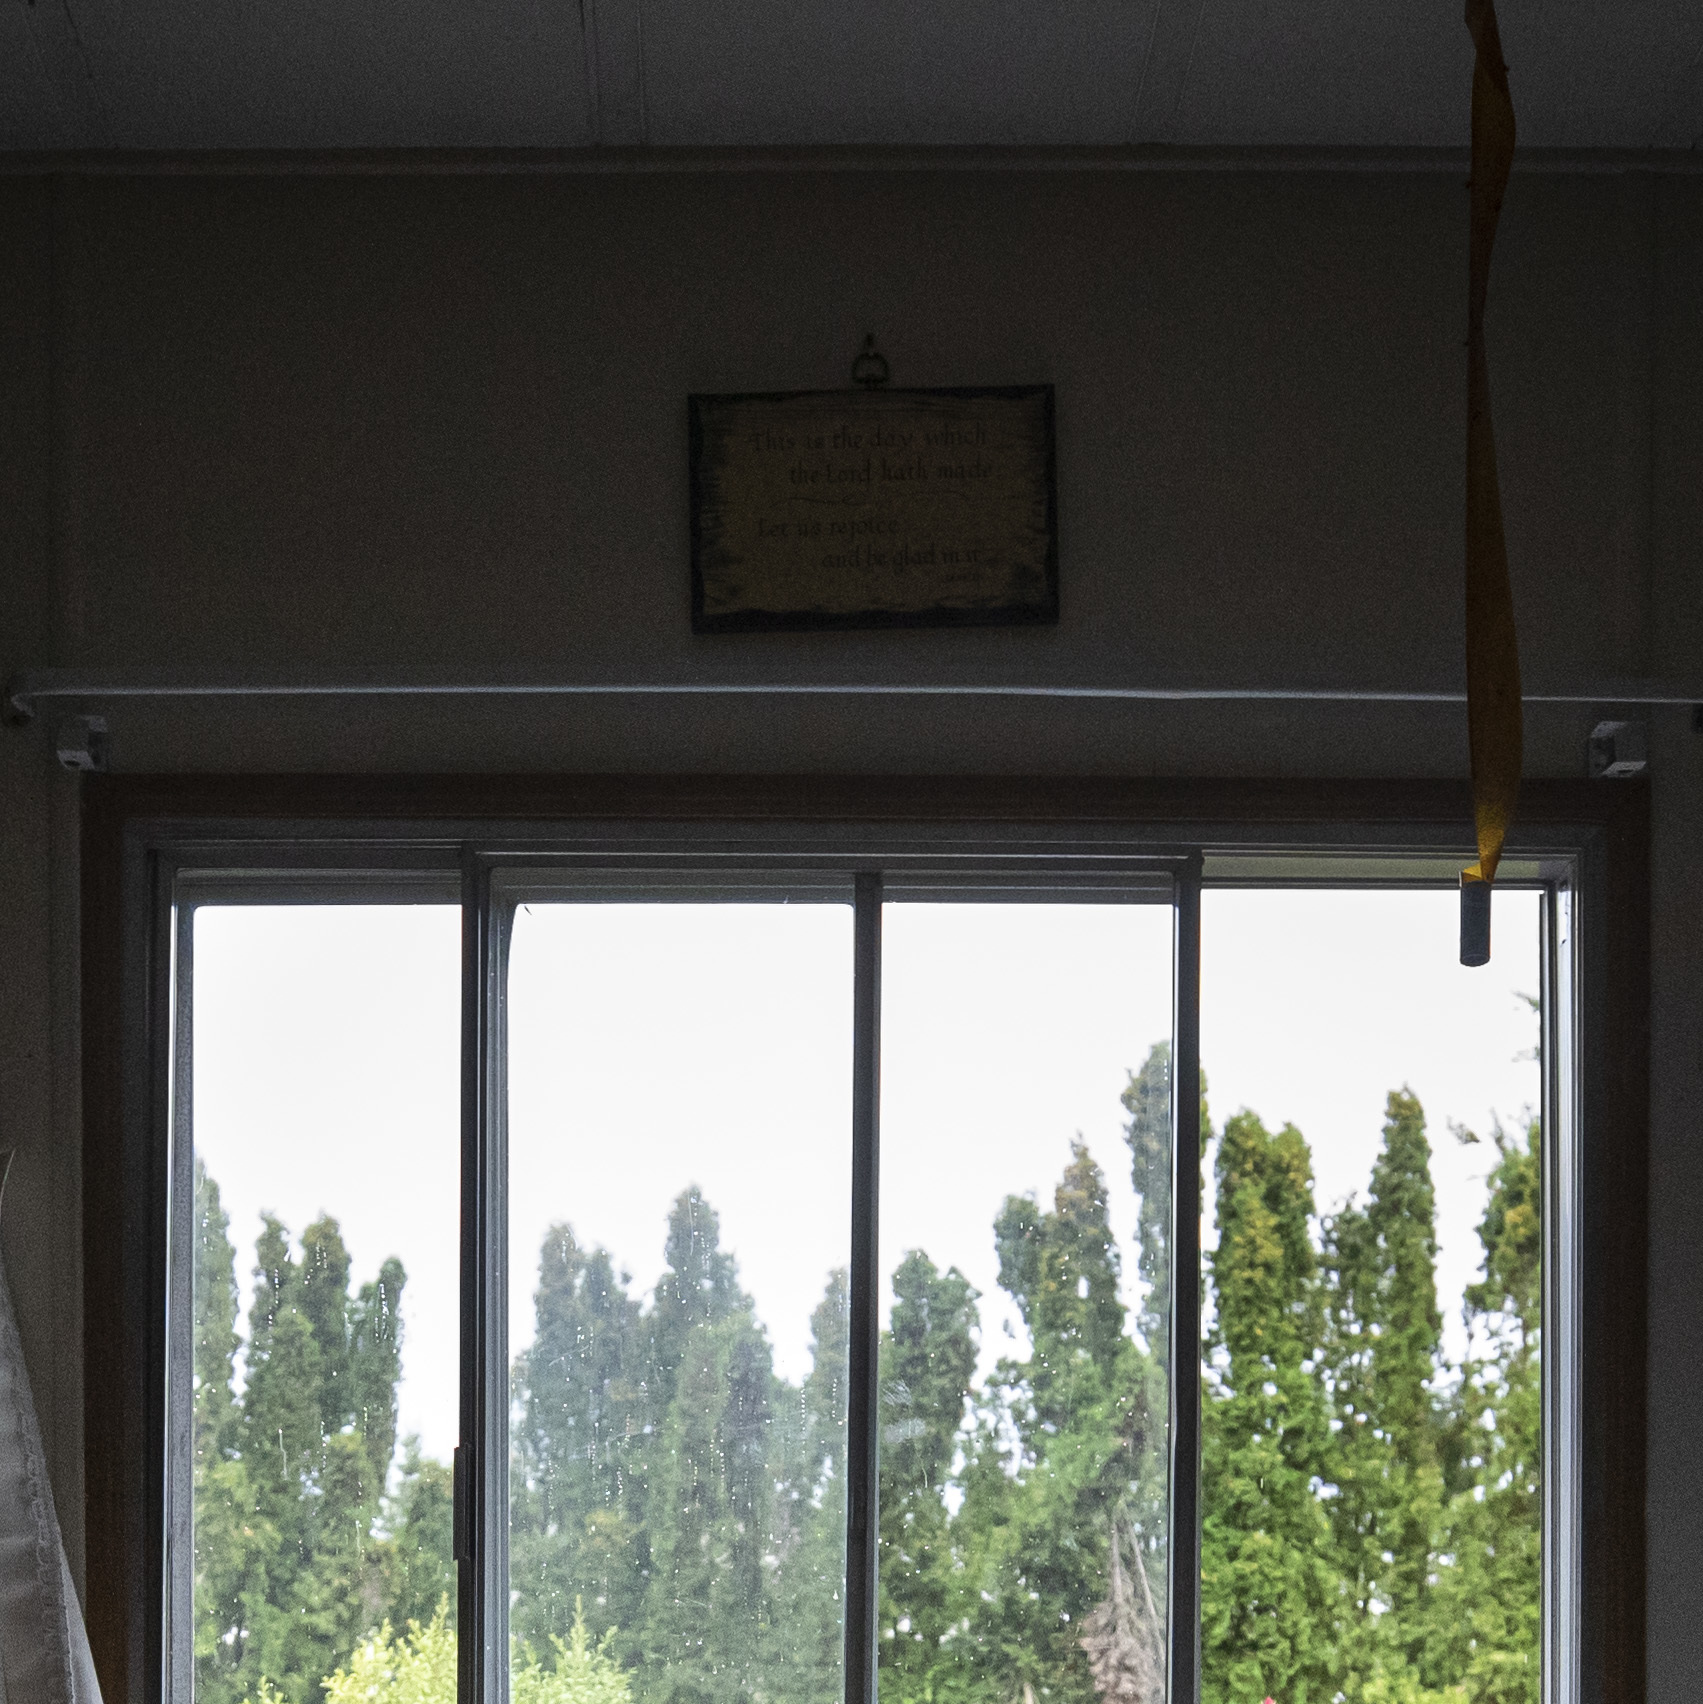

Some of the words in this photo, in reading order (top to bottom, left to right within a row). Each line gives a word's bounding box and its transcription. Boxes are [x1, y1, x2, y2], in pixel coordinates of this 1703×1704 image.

[752, 431, 795, 452] This
[806, 433, 825, 449] is
[833, 426, 862, 449] the
[869, 426, 914, 452] day
[924, 423, 987, 446] which
[789, 460, 817, 484] the
[826, 459, 871, 483] Lord
[882, 458, 929, 480] hath
[937, 456, 992, 479] made
[758, 517, 789, 537] Let
[798, 519, 822, 536] us
[828, 518, 899, 539] rejoice
[822, 544, 862, 568] and
[866, 543, 886, 565] be
[893, 543, 936, 576] glad
[941, 549, 960, 563] in
